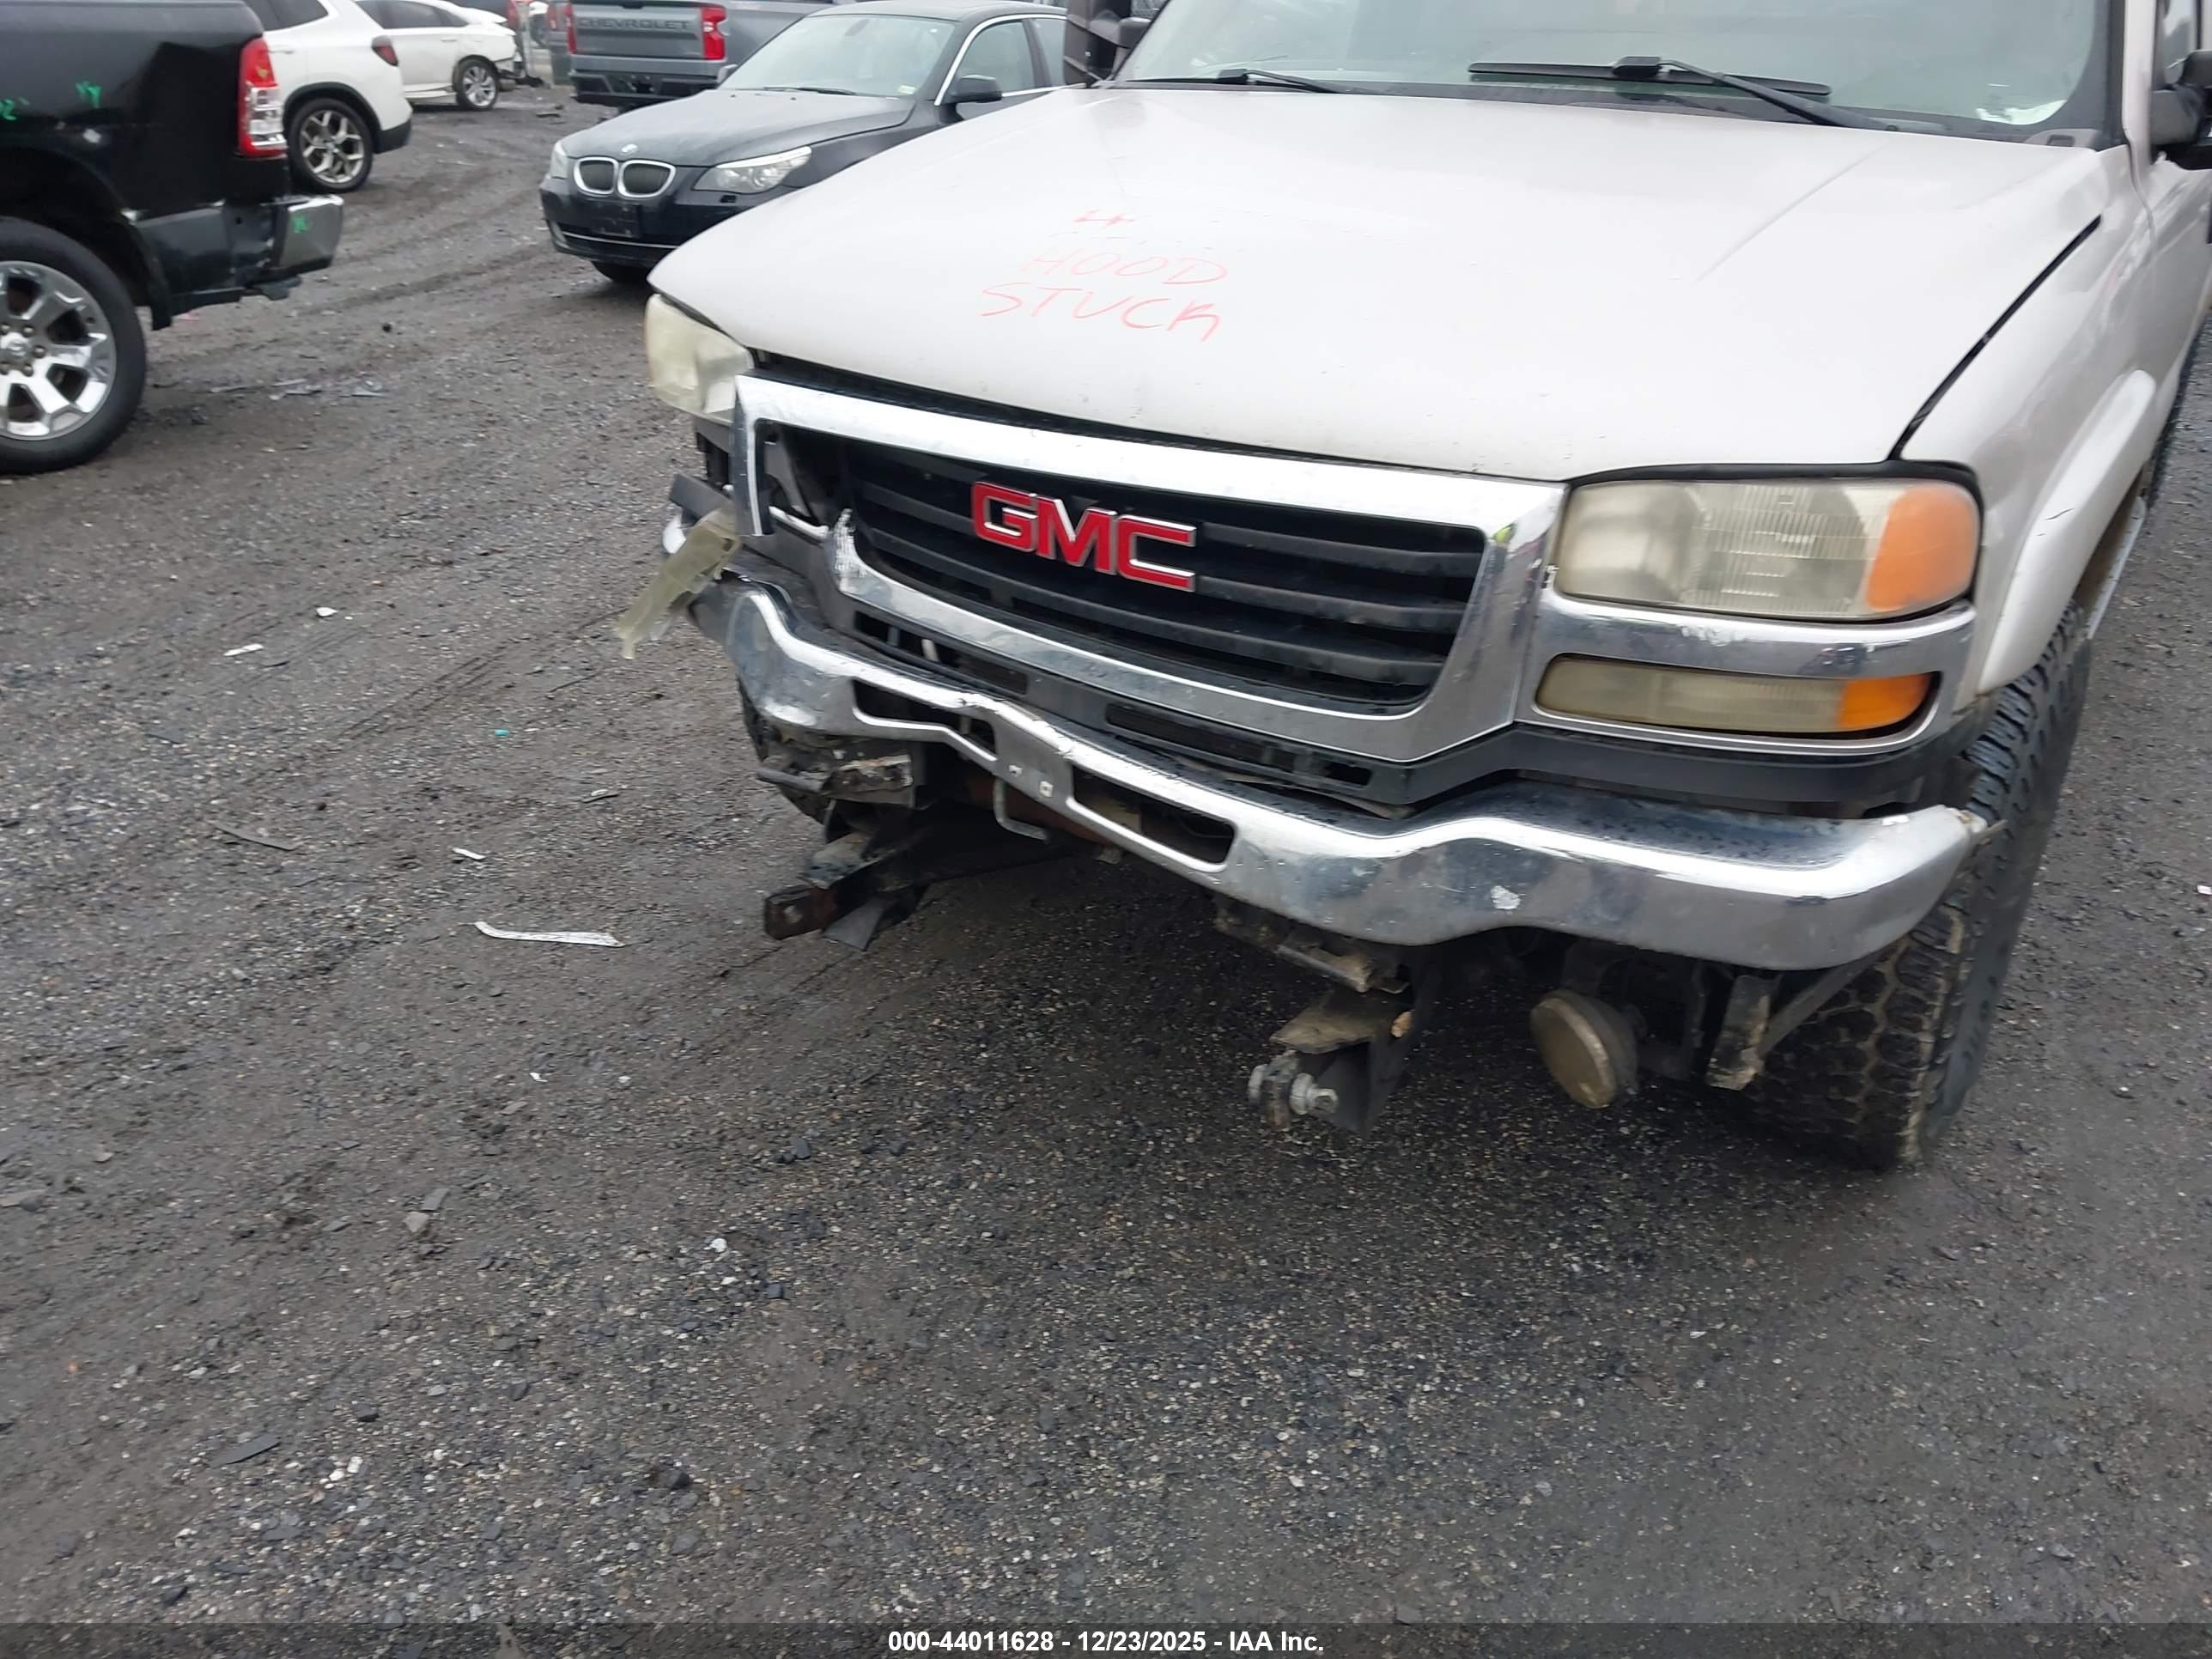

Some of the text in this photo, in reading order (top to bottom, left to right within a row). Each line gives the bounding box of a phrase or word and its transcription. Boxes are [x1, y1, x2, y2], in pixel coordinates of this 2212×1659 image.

[578, 17, 692, 30] CHEVROLET
[1020, 248, 1228, 285] HOOD
[972, 481, 1197, 592] GMC
